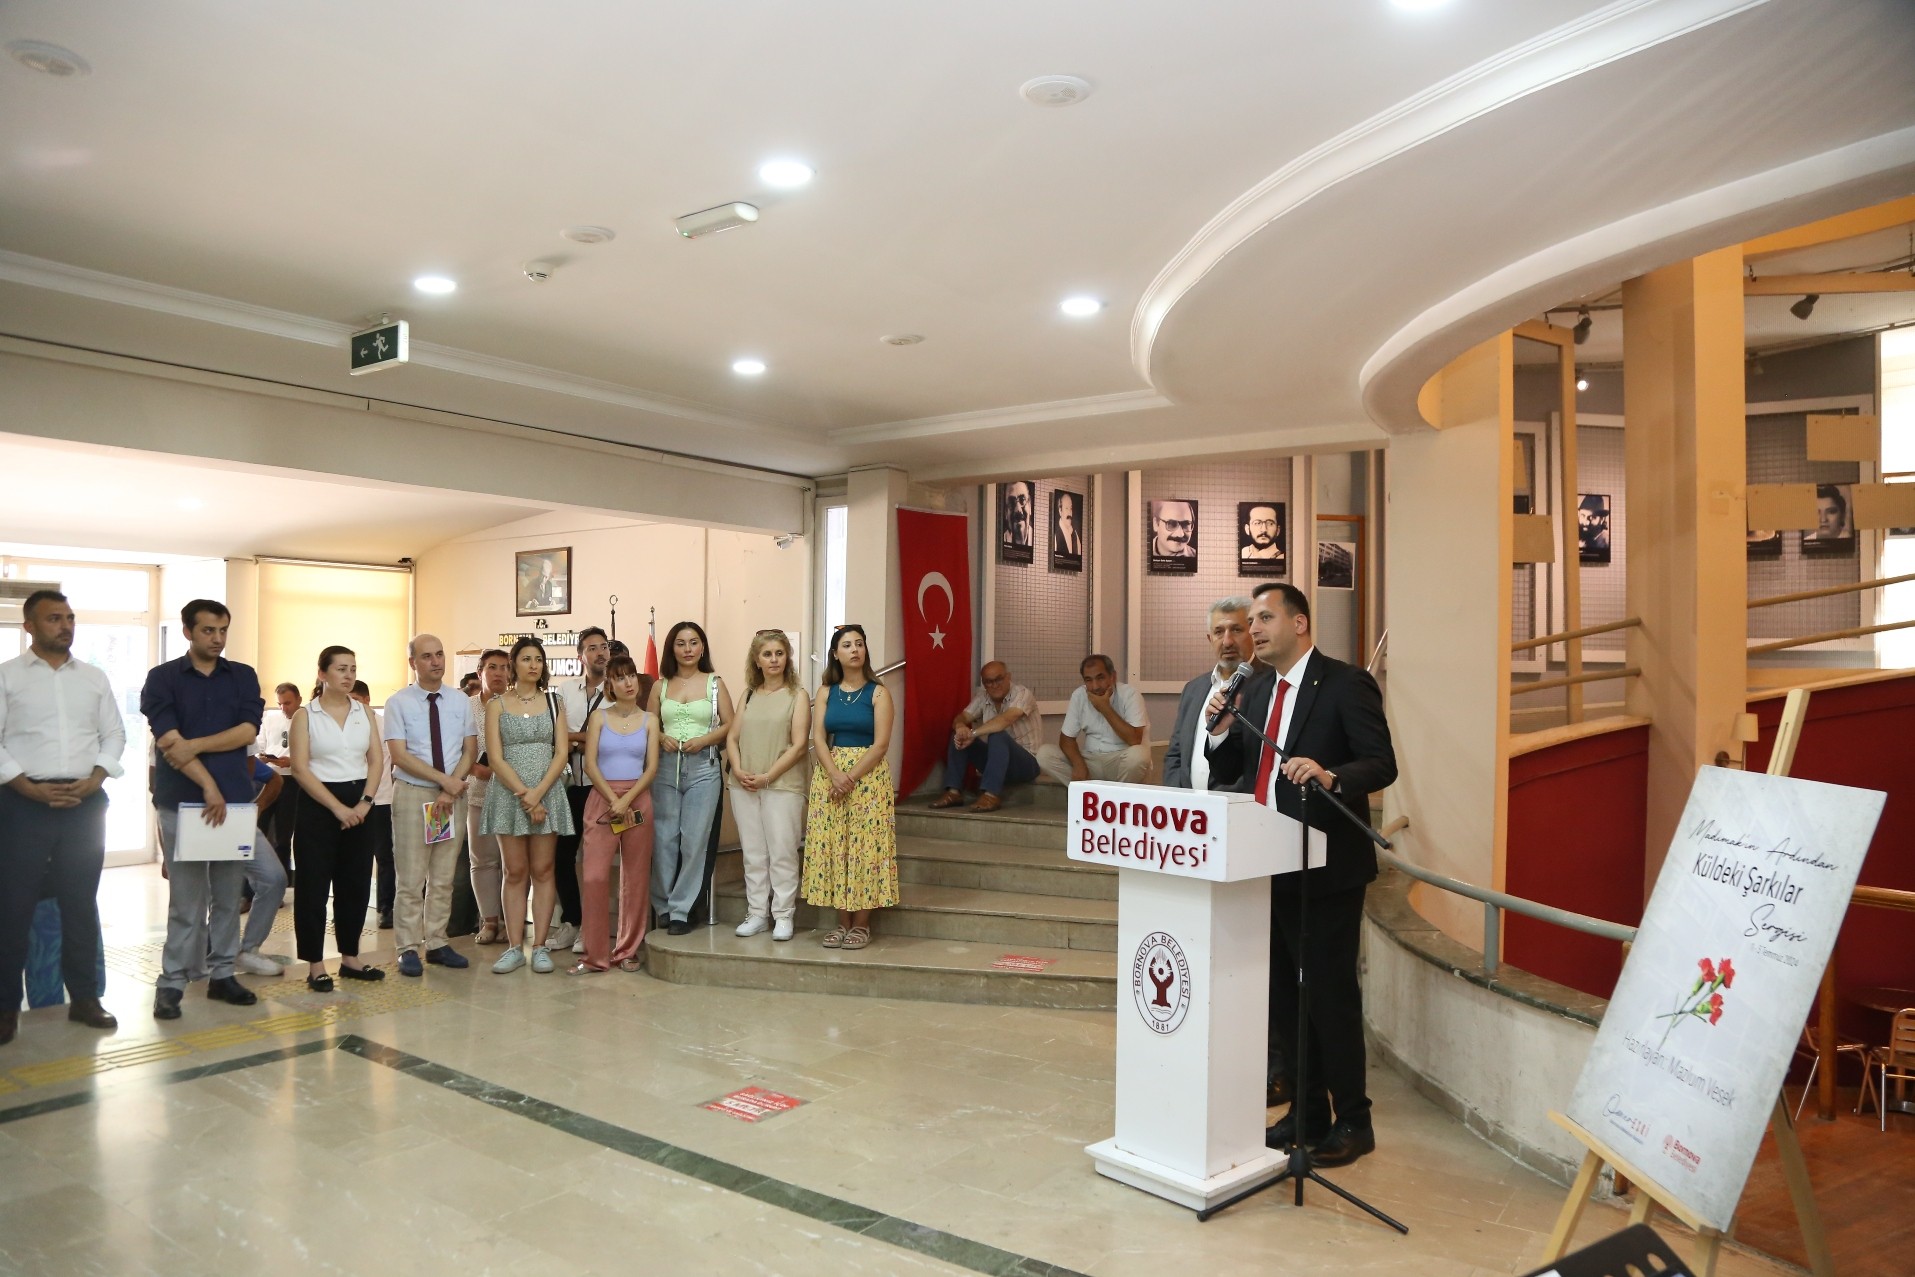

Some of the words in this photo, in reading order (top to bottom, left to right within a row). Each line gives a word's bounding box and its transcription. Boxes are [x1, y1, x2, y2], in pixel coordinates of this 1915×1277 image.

[533, 619, 549, 629] T.C.
[546, 658, 584, 676] UMCU
[1082, 791, 1208, 834] Bornova
[1081, 828, 1208, 869] Belediyesi
[1692, 852, 1746, 888] Küldeki
[1742, 866, 1804, 905] Şarkılar
[1743, 903, 1808, 942] Sergisi
[1134, 936, 1158, 987] BORNOVA
[1152, 1020, 1169, 1031] 1881
